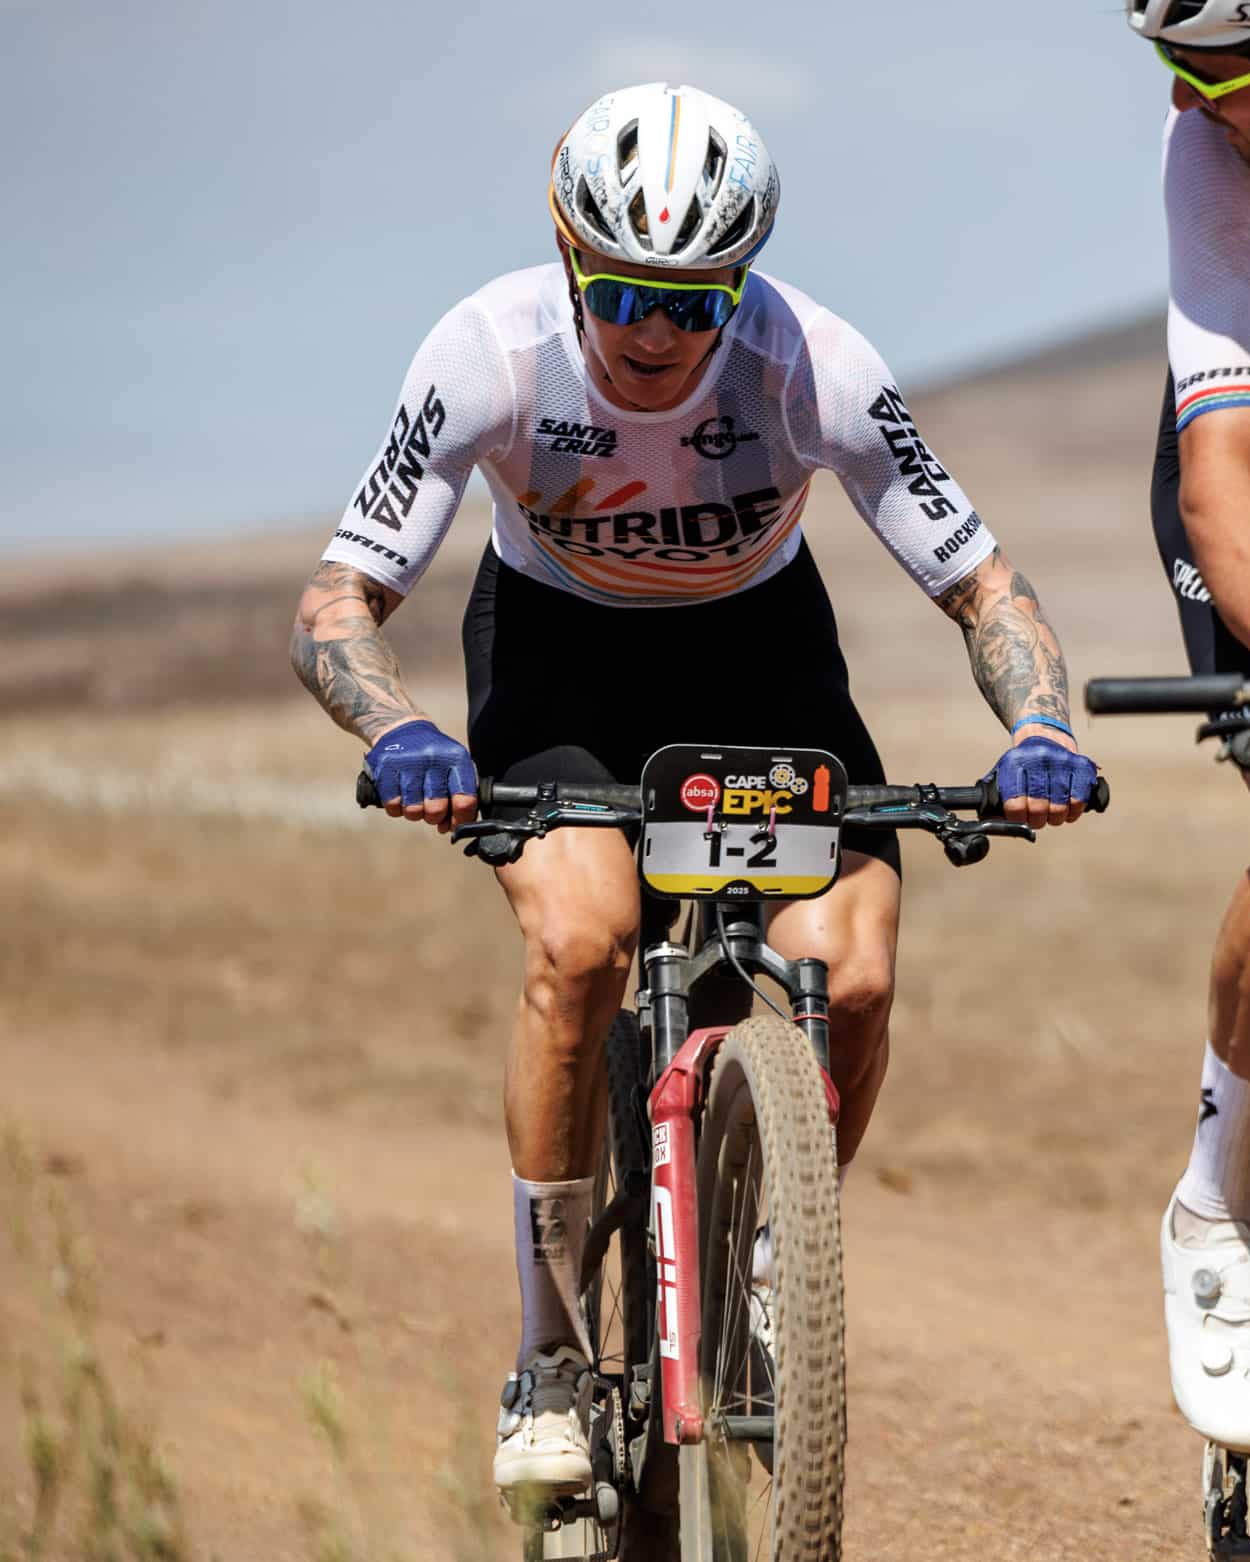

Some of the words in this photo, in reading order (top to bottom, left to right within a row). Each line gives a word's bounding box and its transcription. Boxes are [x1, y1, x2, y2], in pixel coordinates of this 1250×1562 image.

[536, 419, 617, 443] SANTA
[371, 384, 446, 532] SANTA
[550, 438, 617, 457] CRUZ
[867, 392, 959, 521] SANTA
[686, 786, 715, 798] absa
[724, 775, 767, 789] CAPE
[722, 788, 793, 815] EPIC
[703, 831, 777, 868] 1-2
[726, 887, 750, 895] 2025
